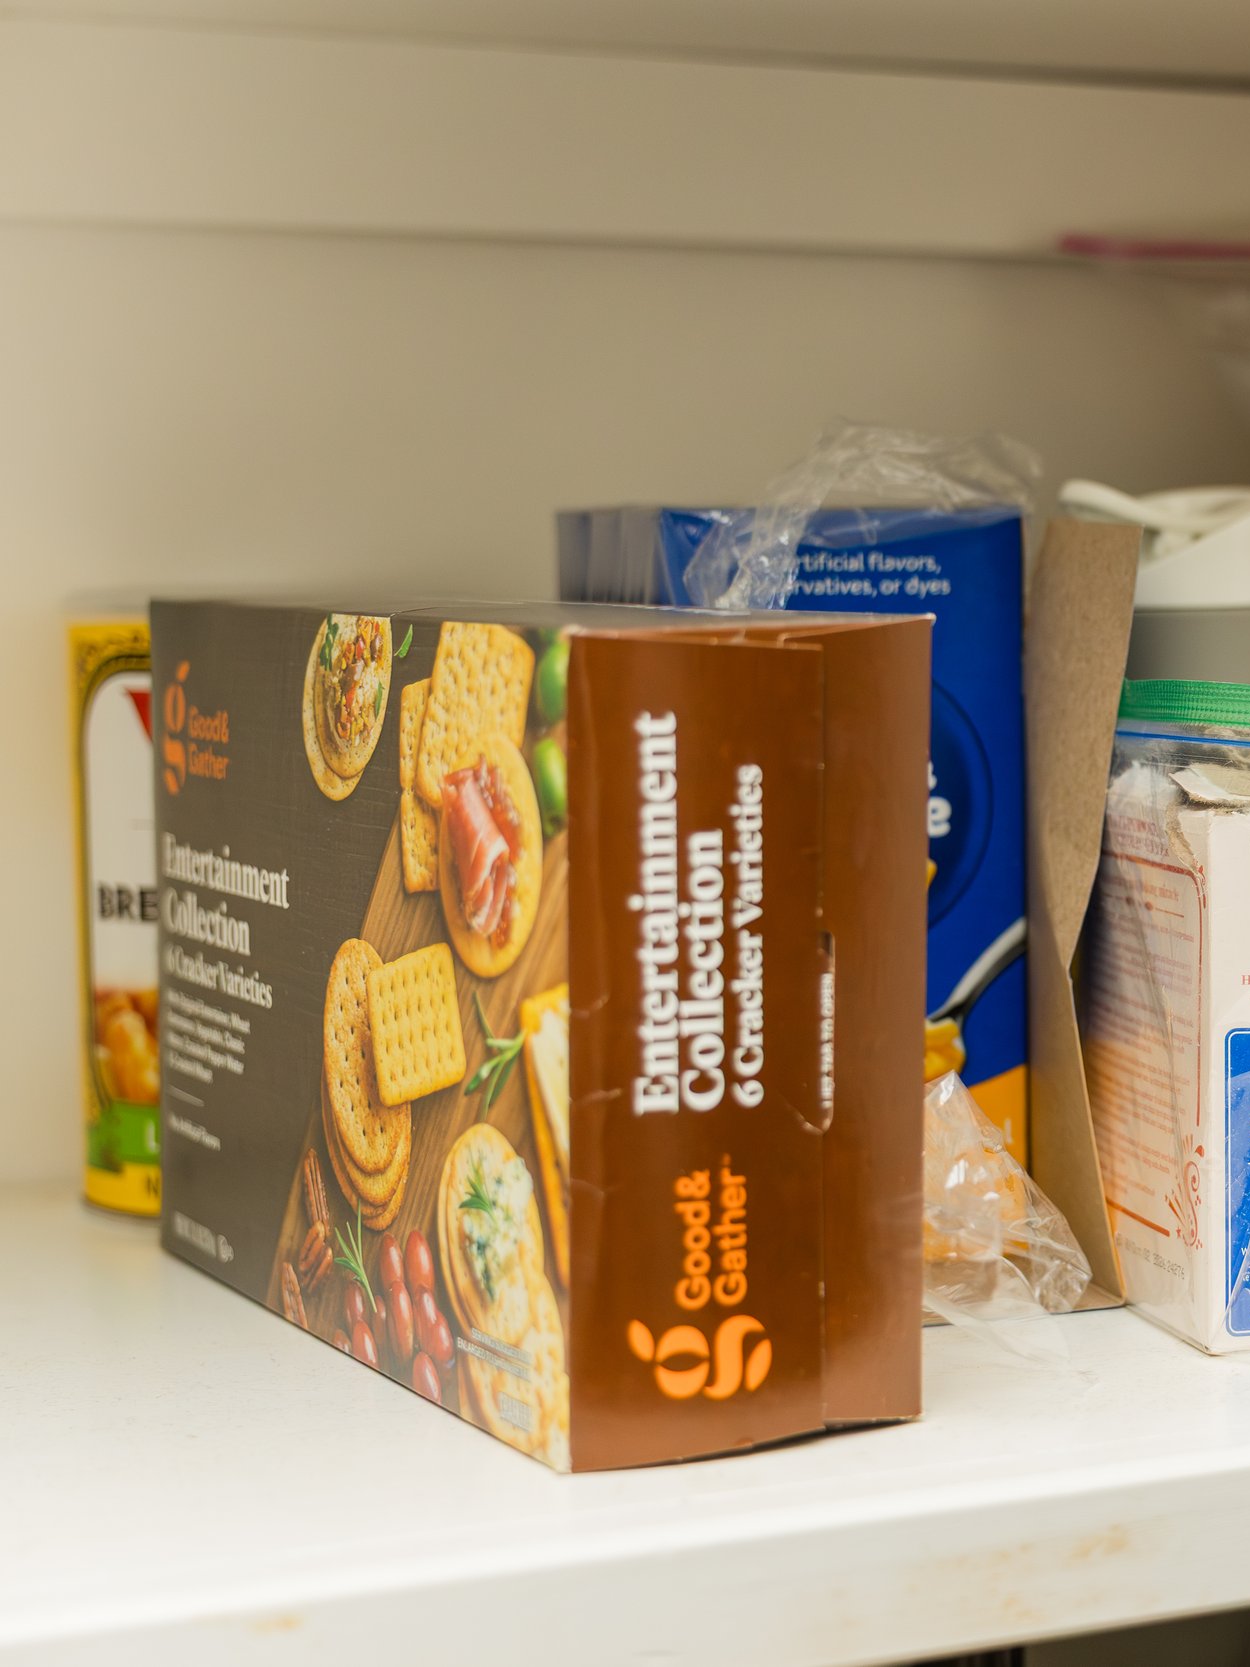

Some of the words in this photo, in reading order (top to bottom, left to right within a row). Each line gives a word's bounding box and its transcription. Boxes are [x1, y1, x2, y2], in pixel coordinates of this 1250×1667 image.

[791, 551, 864, 572] rtificial
[868, 550, 942, 574] flavors,
[879, 580, 901, 595] or
[904, 576, 951, 599] dyes
[162, 831, 290, 909] Entertainment
[728, 763, 764, 929] Varieties
[162, 886, 251, 956] Collection
[627, 711, 679, 1116] Entertainment
[174, 947, 218, 990] Cracker
[218, 960, 273, 1010] Varieties
[677, 829, 725, 1112] Collection
[728, 930, 764, 1078] Cracker
[731, 1079, 764, 1108] 6
[712, 1167, 748, 1306] Gather
